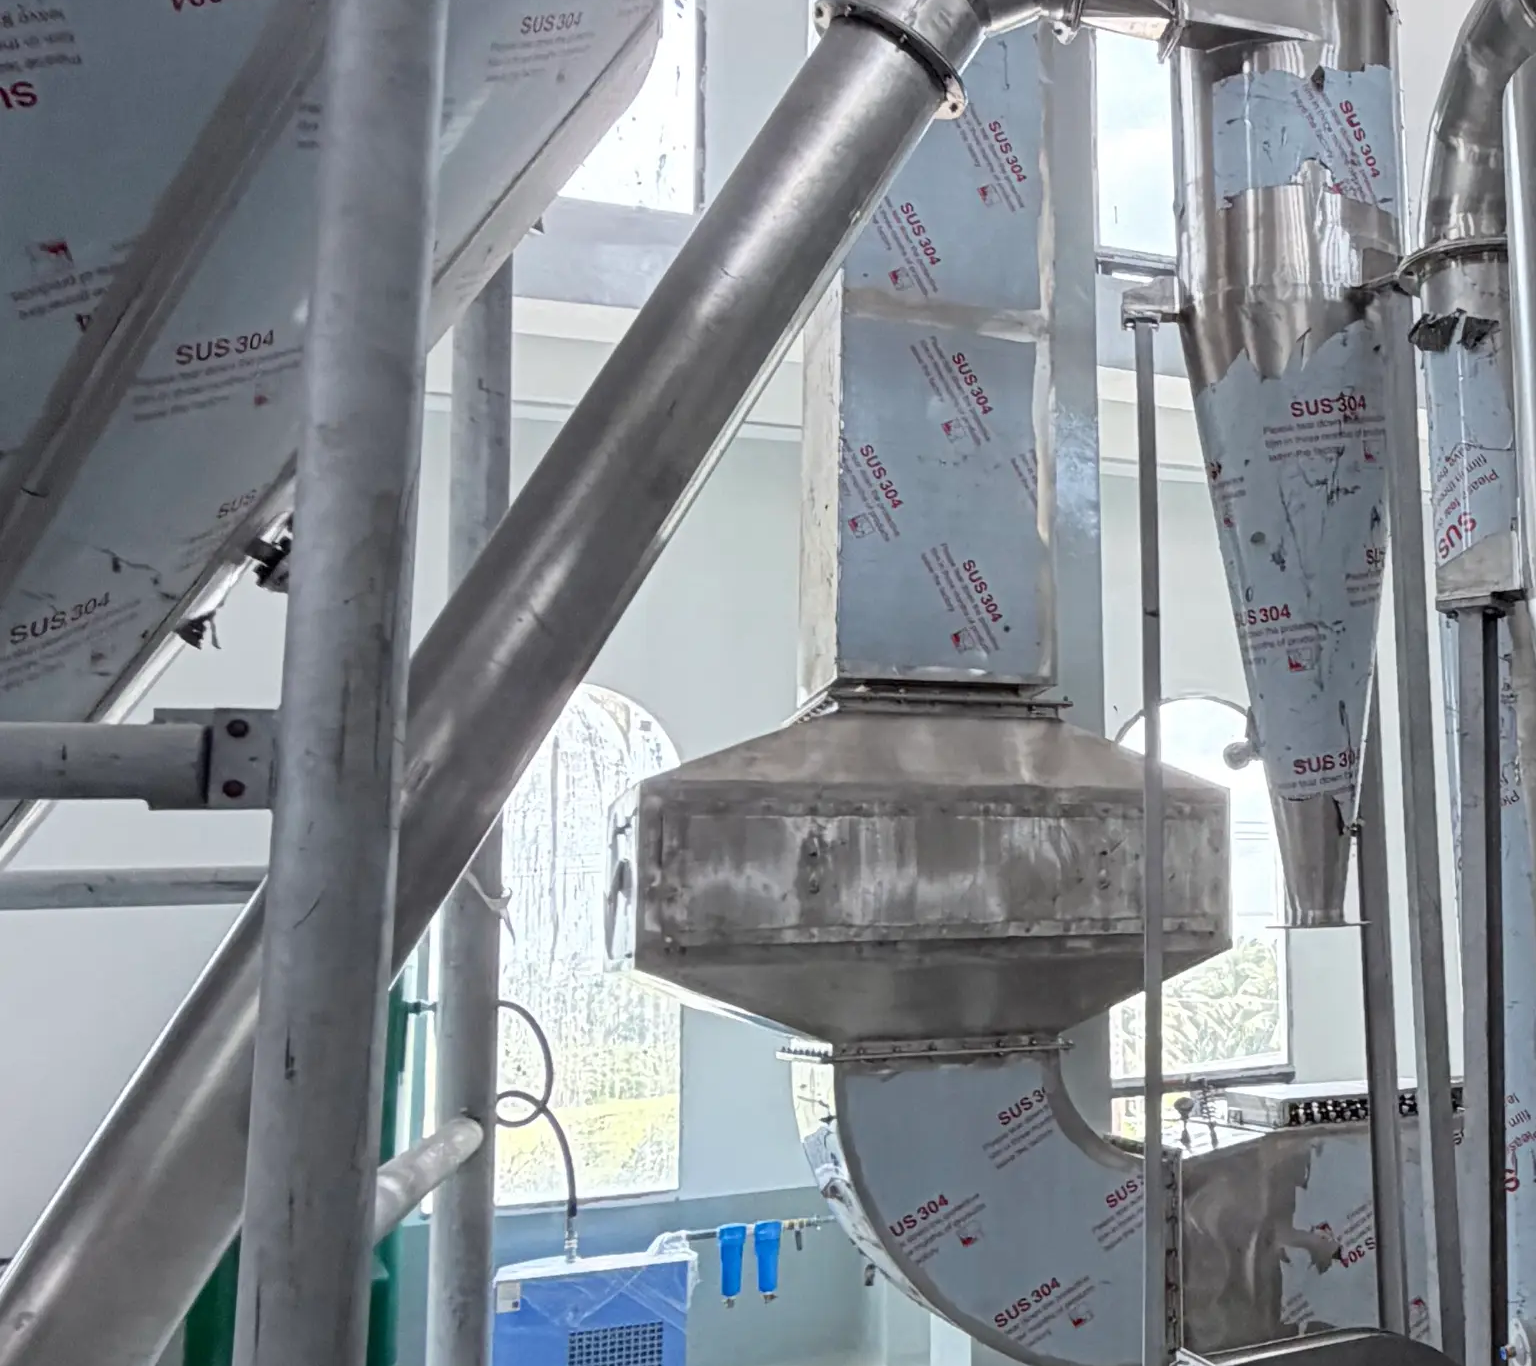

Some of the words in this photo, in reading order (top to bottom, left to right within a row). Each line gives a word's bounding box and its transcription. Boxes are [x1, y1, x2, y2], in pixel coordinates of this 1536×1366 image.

[519, 14, 556, 35] SUS
[988, 119, 1014, 155] SUS
[1005, 154, 1028, 183] 304
[1339, 99, 1367, 143] SUS
[1360, 143, 1381, 178] 304
[899, 201, 927, 237] SUS
[918, 237, 942, 267] 304
[175, 338, 232, 367] SUS
[234, 328, 275, 355] 304
[951, 351, 979, 387] SUS
[969, 386, 995, 416] 304
[1290, 398, 1334, 419] SUS
[1335, 394, 1367, 414] 304
[859, 443, 888, 480] SUS
[879, 479, 905, 510] 304
[962, 558, 989, 595] SUS
[980, 593, 1004, 623] 304
[9, 609, 68, 646] SUS
[1258, 603, 1292, 624] 304
[1293, 754, 1335, 775] SUS
[997, 1096, 1034, 1126] SUS
[1105, 1178, 1139, 1209] SUS
[889, 1213, 918, 1238] US
[916, 1194, 950, 1221] 304
[994, 1297, 1032, 1328] SUS
[1030, 1276, 1061, 1304] 304
